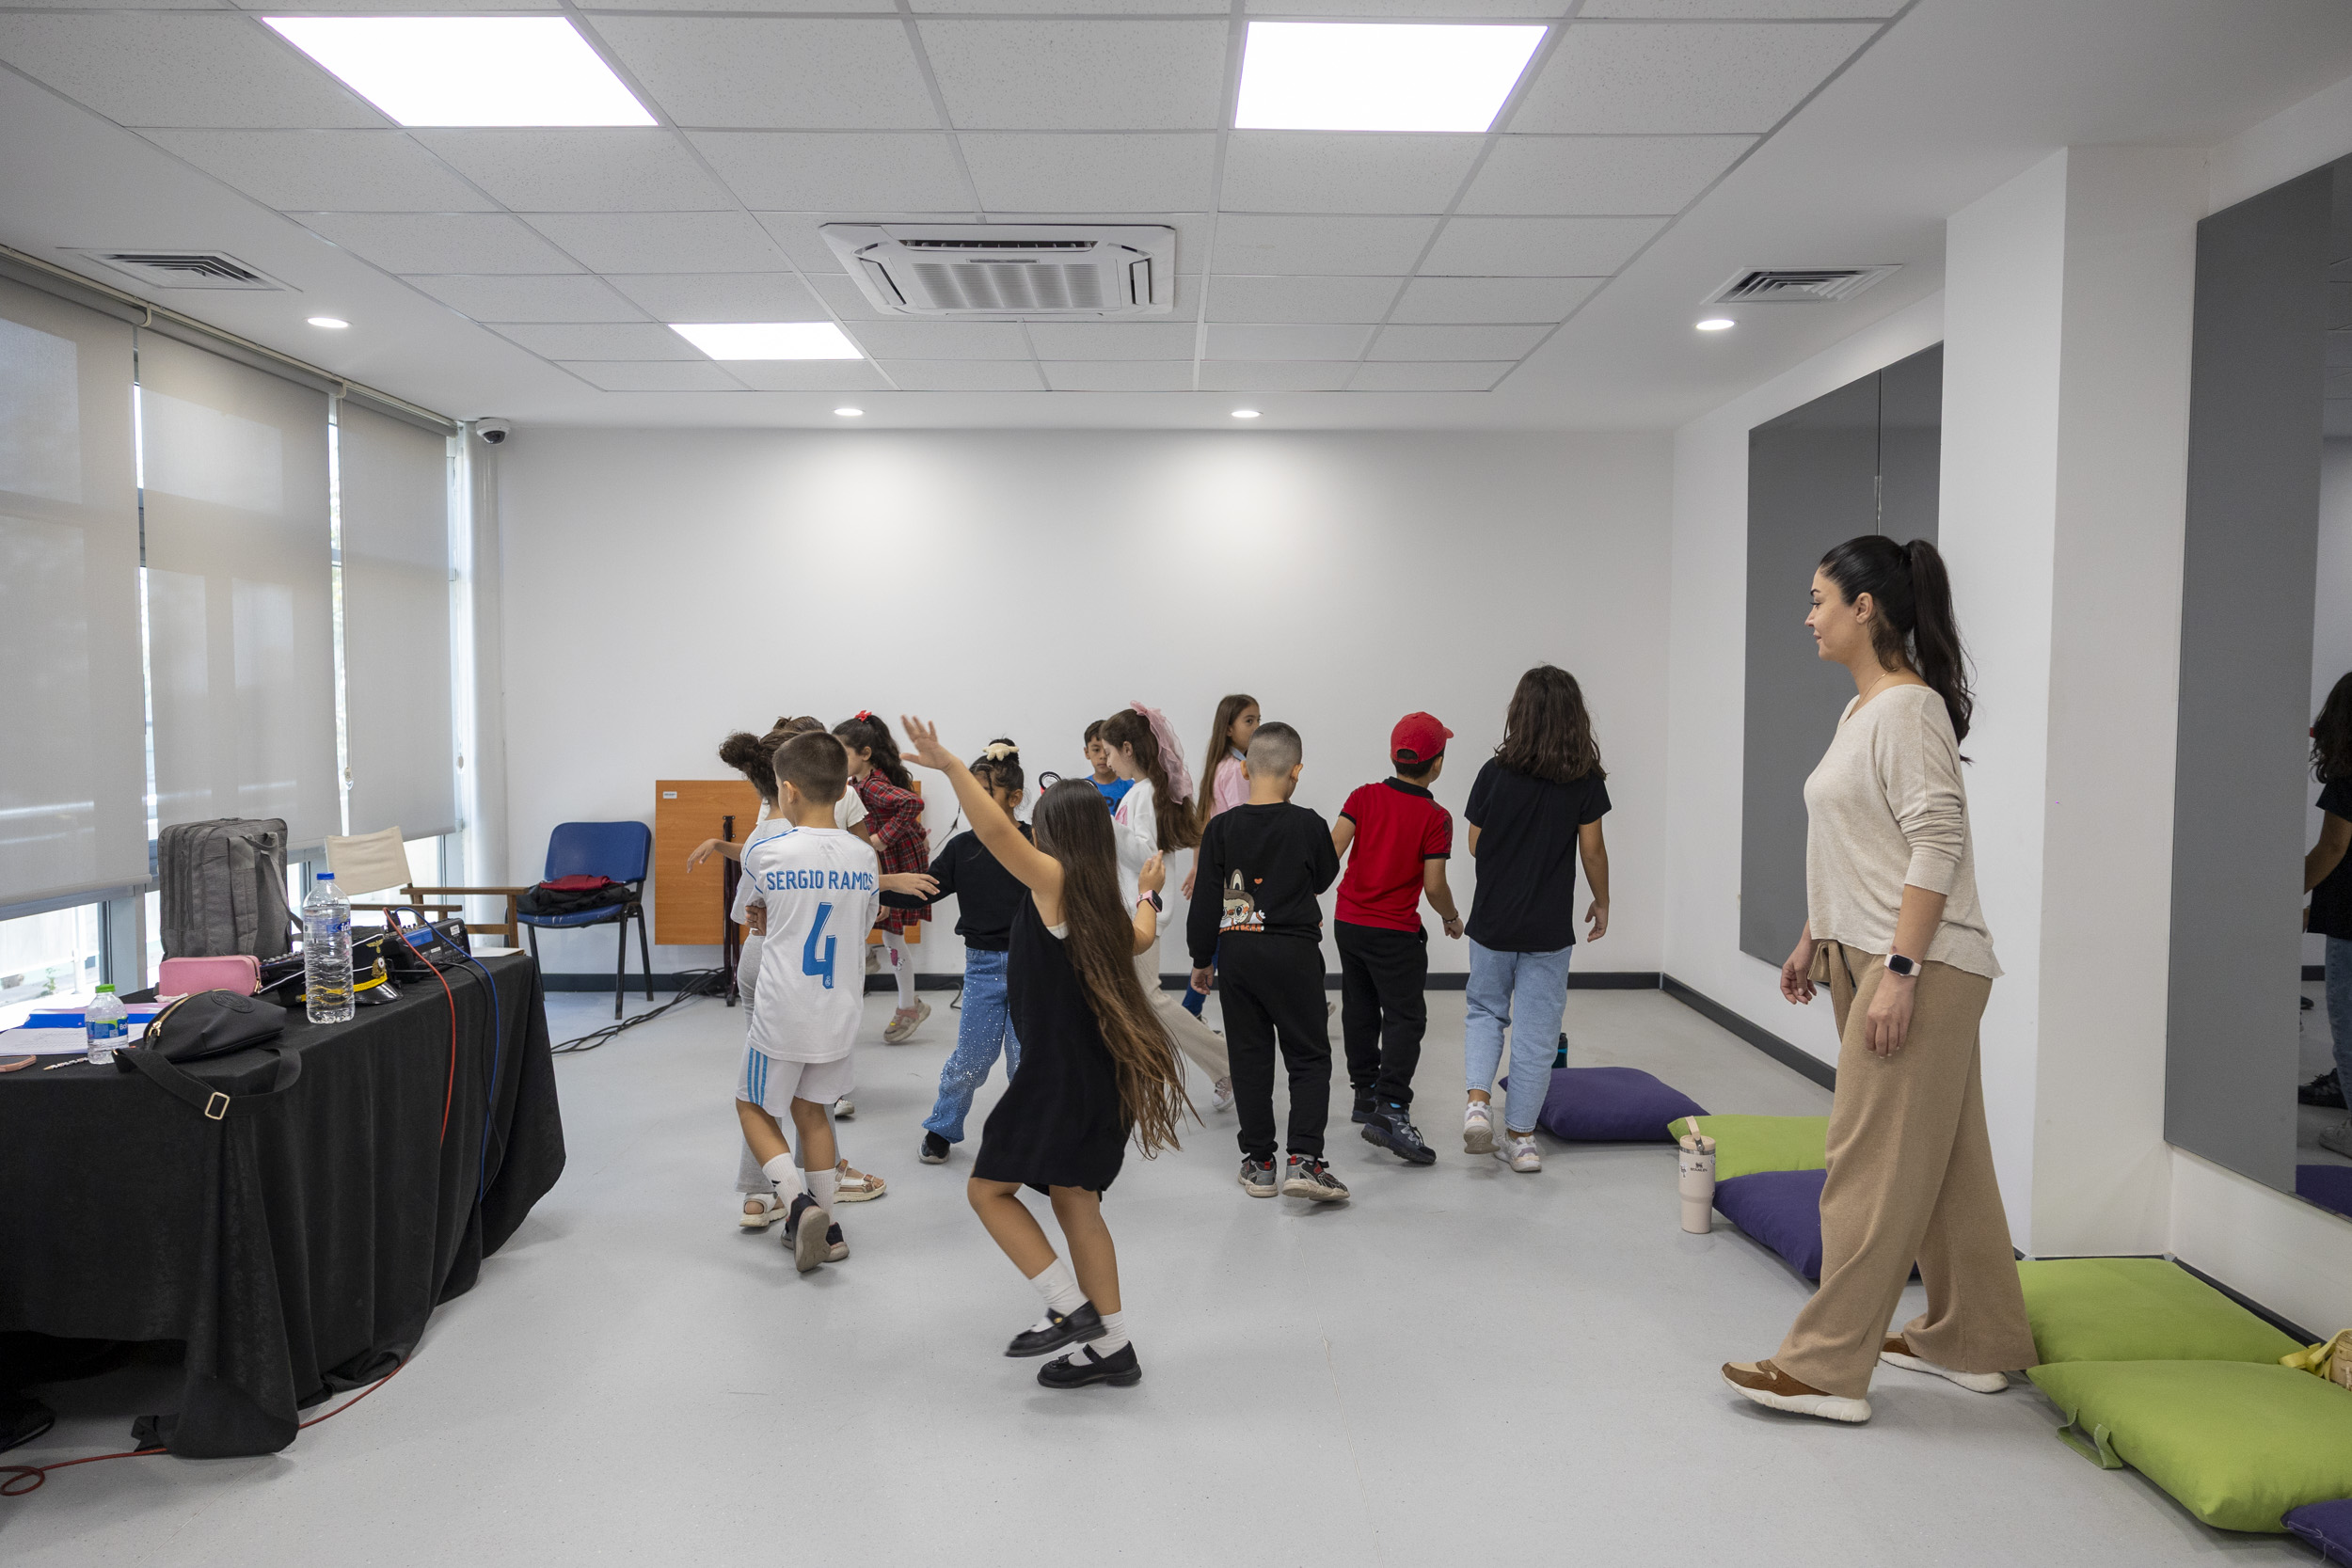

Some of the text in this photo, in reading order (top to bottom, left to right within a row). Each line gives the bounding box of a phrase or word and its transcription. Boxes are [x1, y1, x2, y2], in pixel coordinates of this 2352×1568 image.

[766, 869, 874, 891] SERGIO RAMOS
[802, 901, 837, 990] 4
